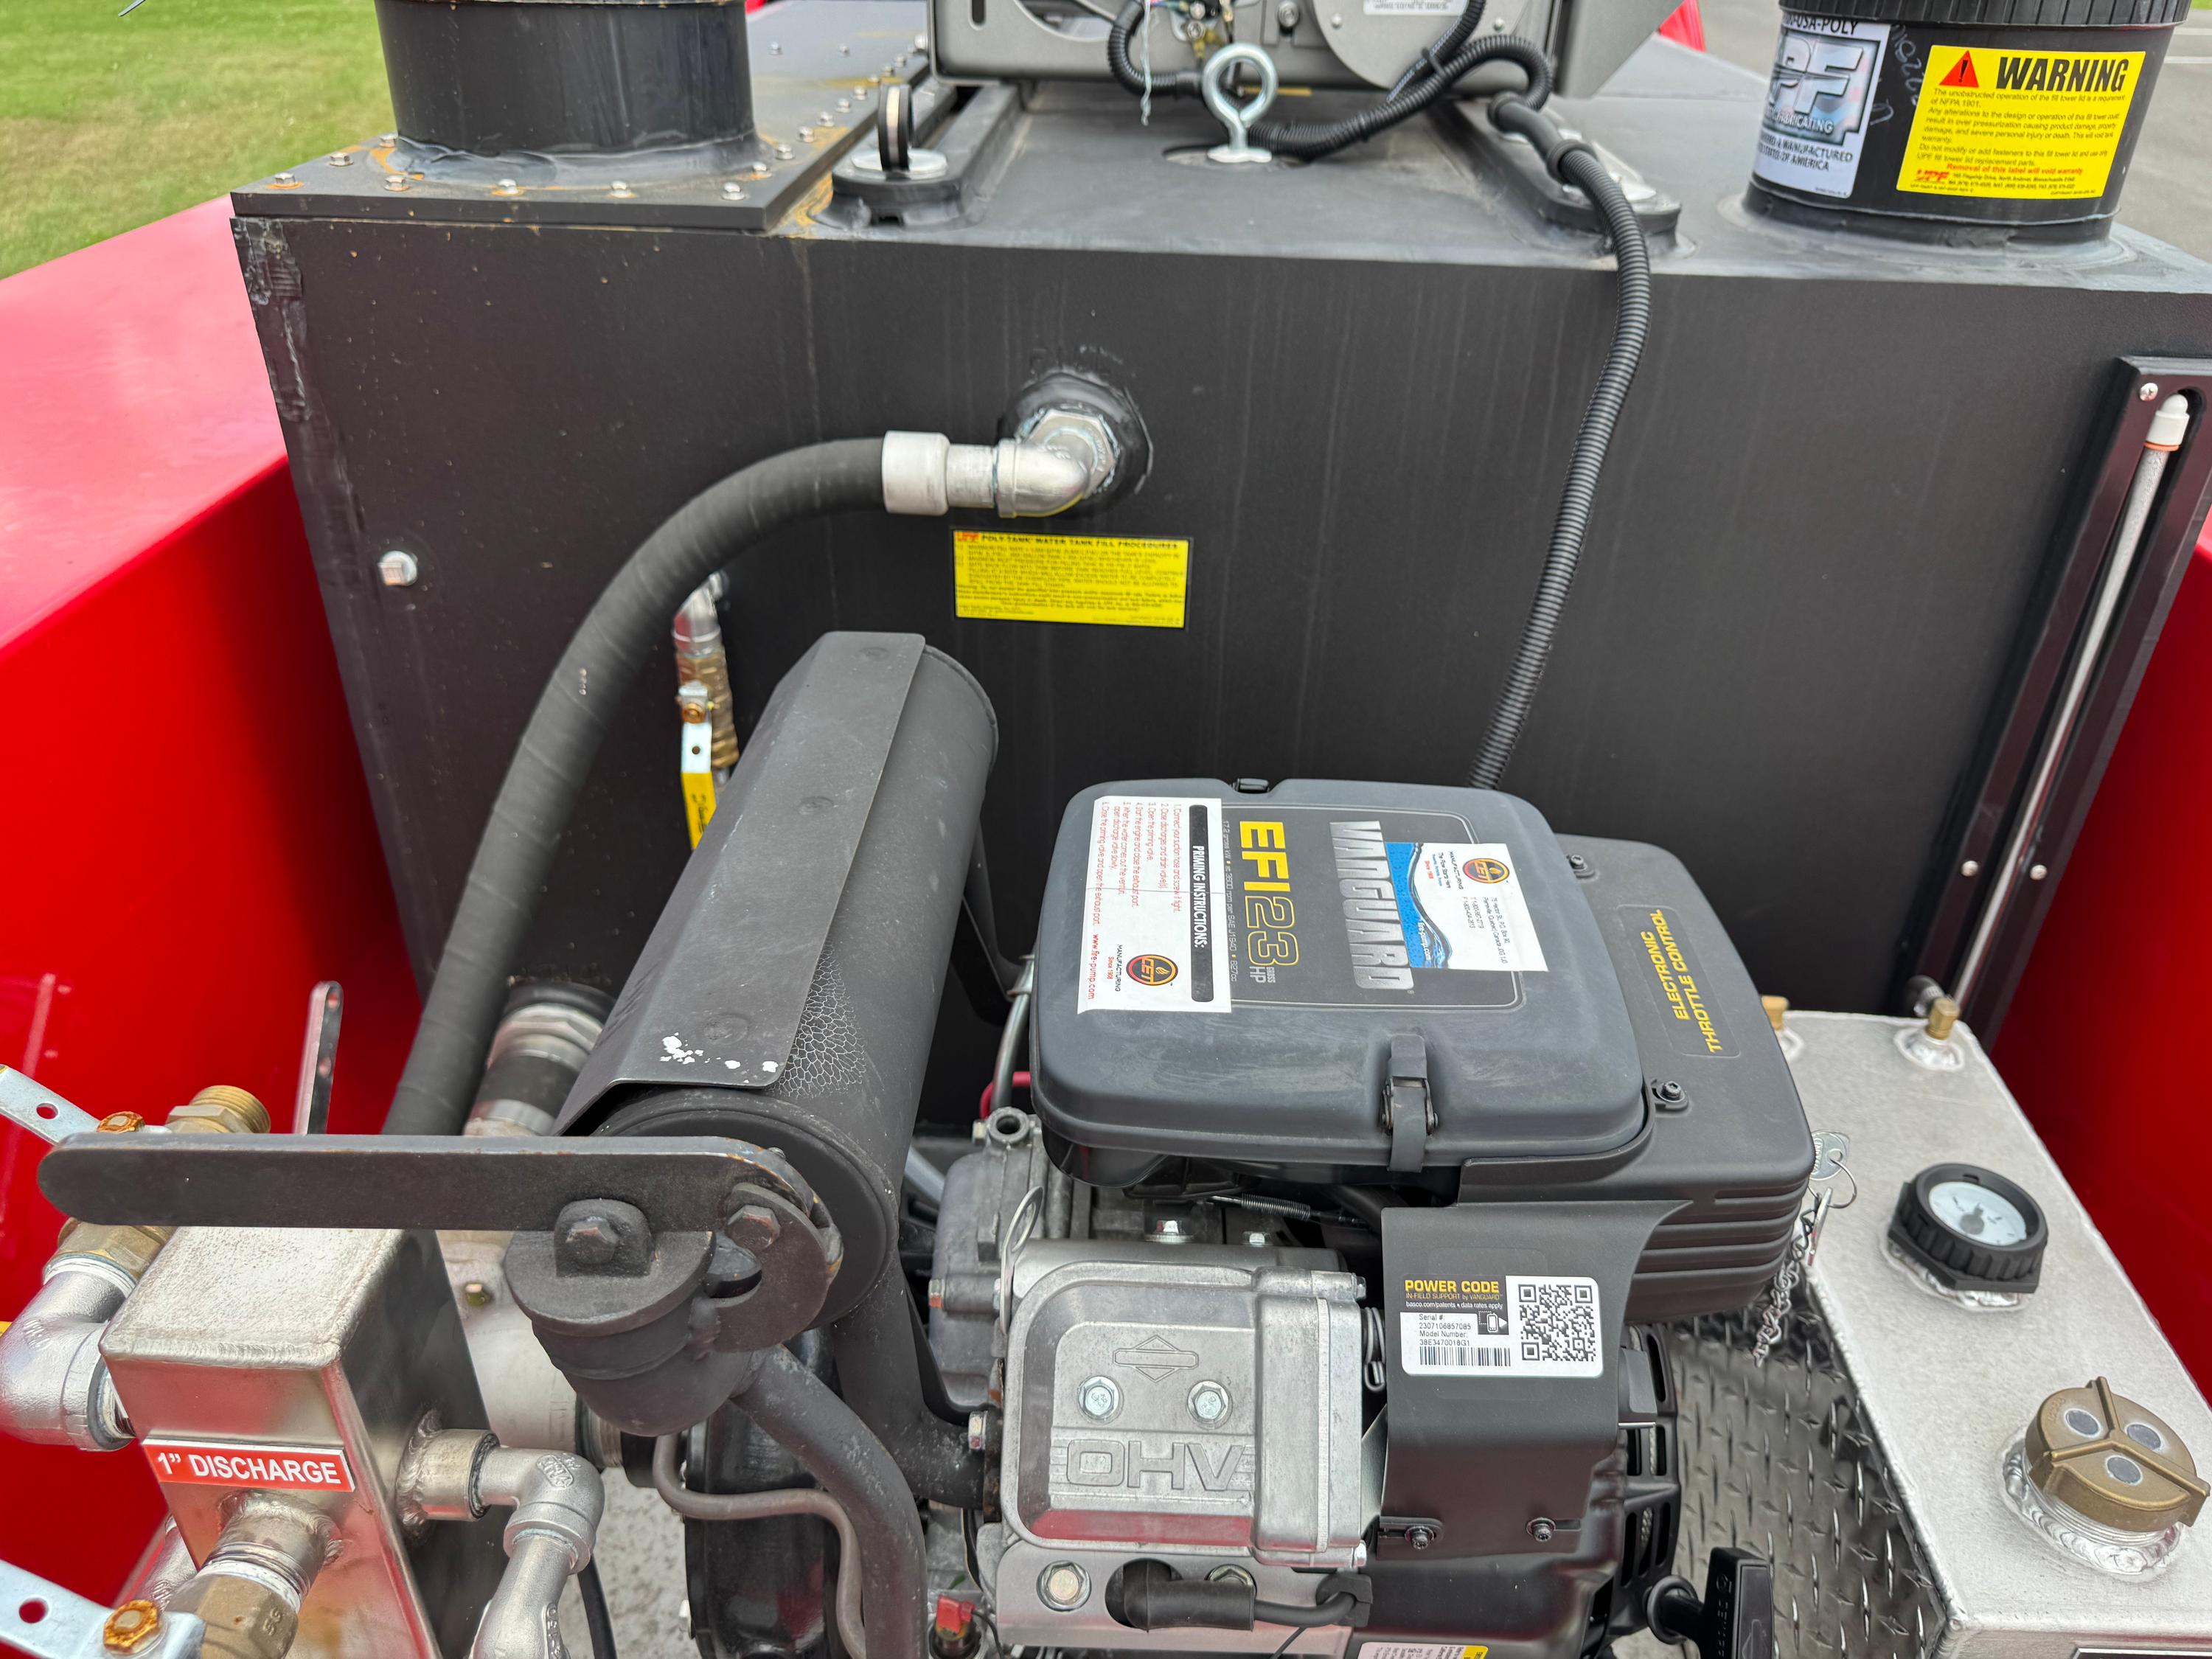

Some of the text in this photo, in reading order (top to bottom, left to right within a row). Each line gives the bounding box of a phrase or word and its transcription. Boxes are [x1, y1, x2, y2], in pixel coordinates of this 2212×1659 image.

[1996, 57, 2129, 92] WARNING
[1100, 806, 1109, 818] Close
[1112, 806, 1120, 817] open
[1147, 807, 1155, 820] Open
[1097, 827, 1107, 844] priming
[1110, 818, 1120, 840] discharge
[1133, 825, 1141, 840] engine
[1145, 830, 1154, 846] priming
[1158, 821, 1167, 844] discharges
[1094, 869, 1103, 882] open
[1448, 851, 1464, 889] MANUFACTURING
[1095, 883, 1103, 891] the
[1193, 846, 1208, 948] PRIMING INSTRUCTIONS:
[1093, 893, 1102, 912] exhaust
[1330, 821, 1413, 990] VANGUARD
[1086, 933, 1100, 999] www.fire-pump.com
[1114, 945, 1122, 992] MANUFACTURING
[1140, 958, 1154, 982] CET
[1249, 966, 1266, 983] HP
[1641, 932, 1690, 1020] ELECTRONIC
[1650, 909, 1722, 1053] THROTTLE CONTROL
[1405, 1280, 1499, 1293] POWER CODE
[188, 1454, 341, 1484] DISCHARGE
[1067, 1439, 1246, 1491] OHV
